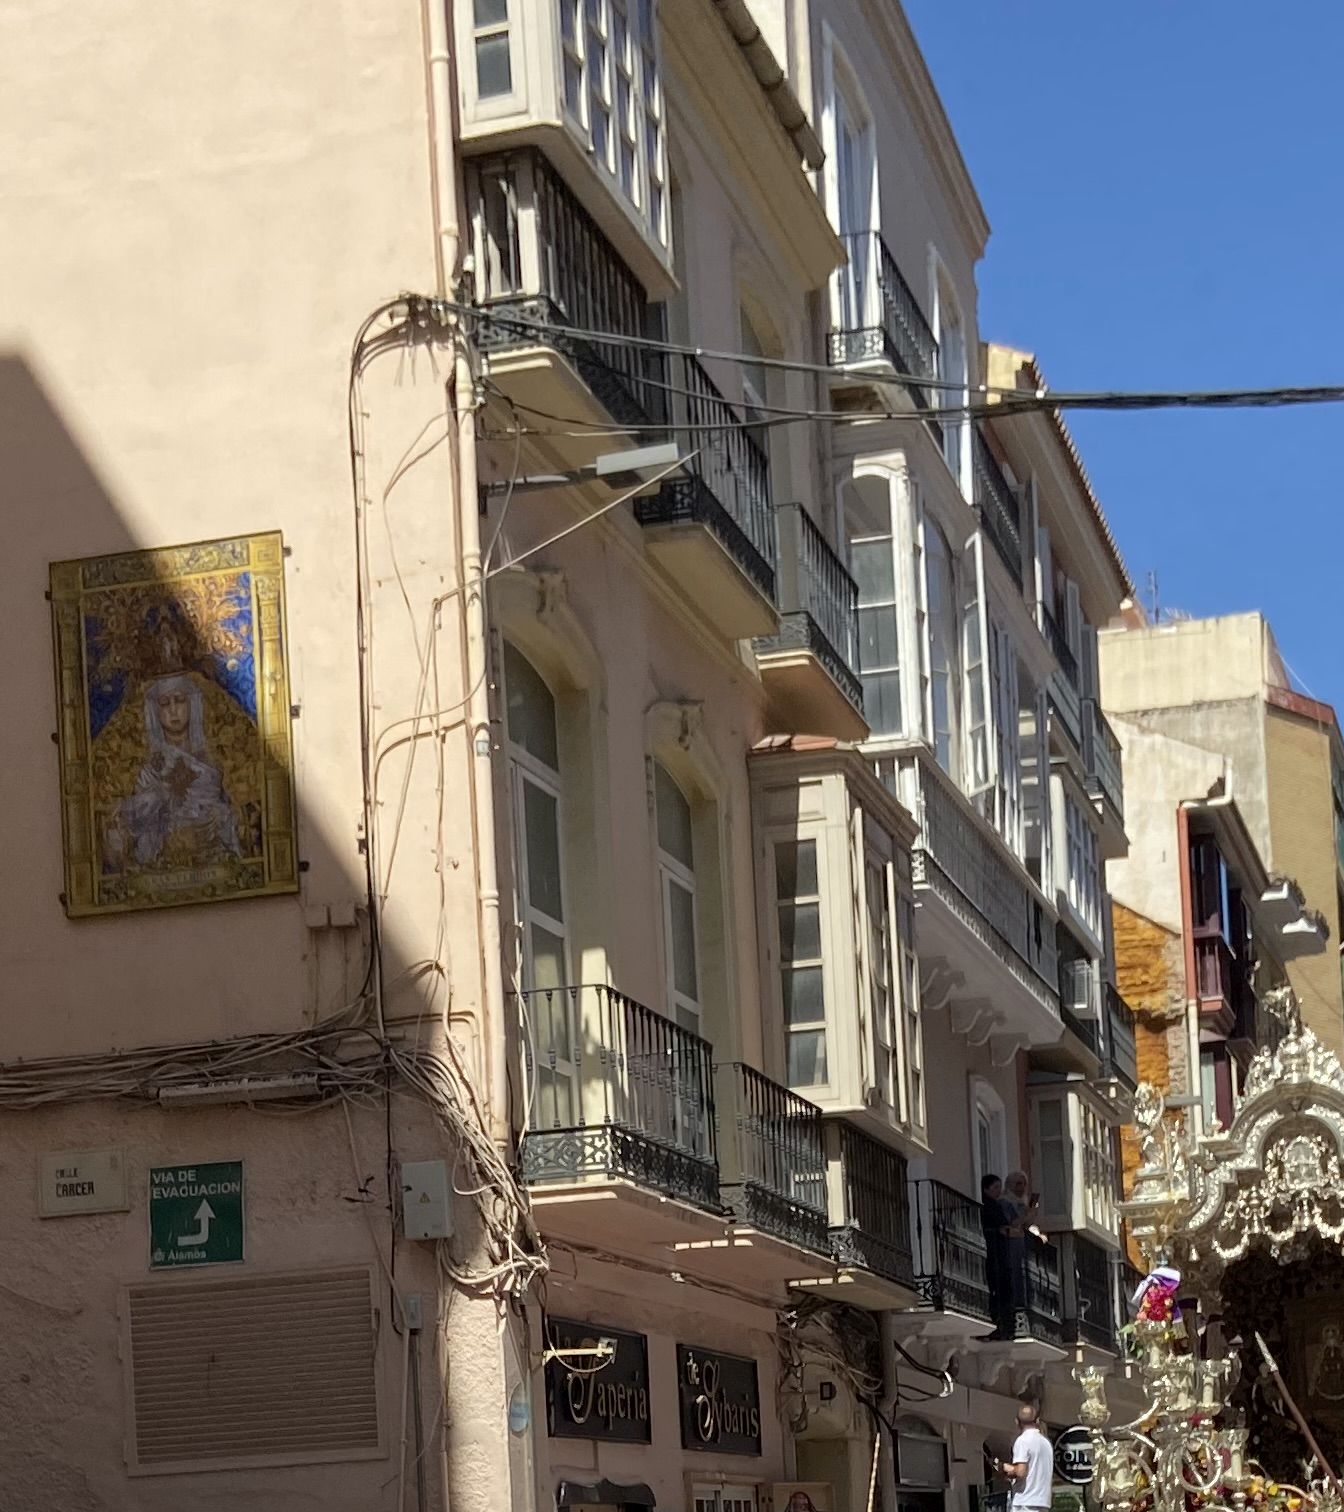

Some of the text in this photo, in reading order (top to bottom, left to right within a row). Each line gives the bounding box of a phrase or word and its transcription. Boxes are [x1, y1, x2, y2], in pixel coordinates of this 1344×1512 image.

[152, 1169, 197, 1184] VIA DE
[152, 1181, 240, 1200] EVACUACION
